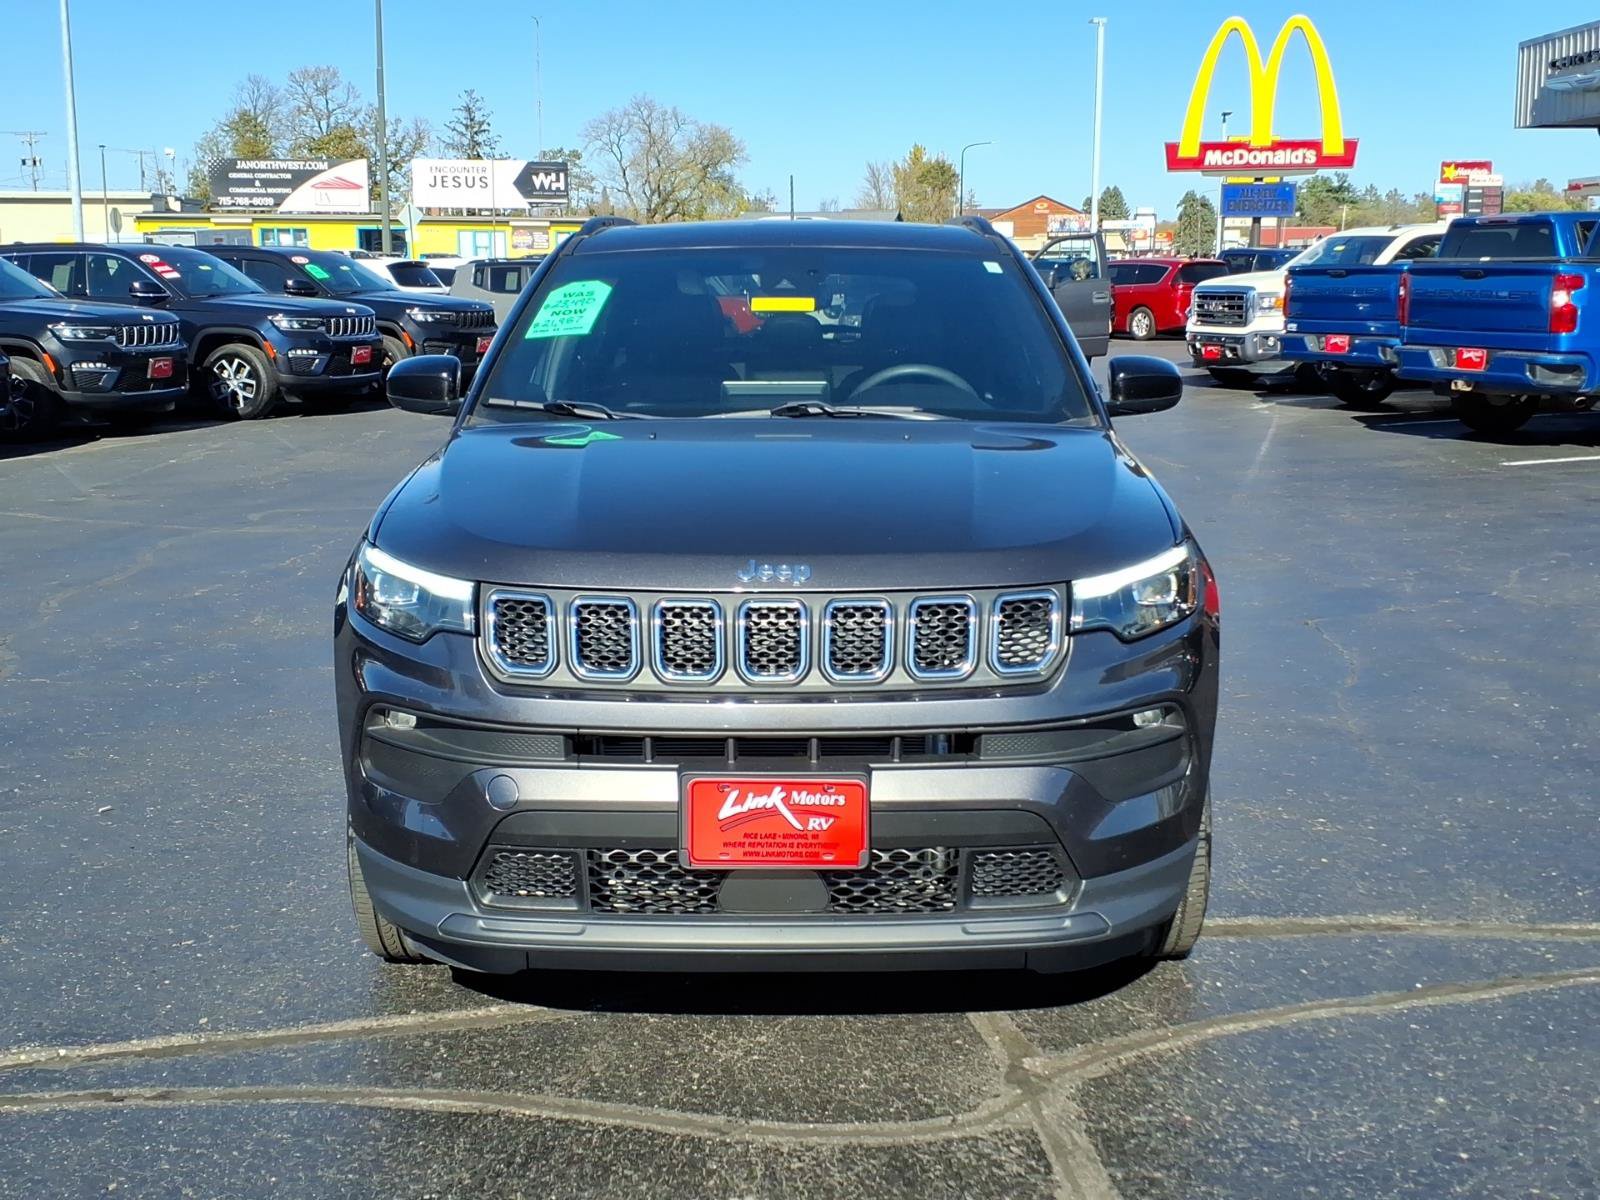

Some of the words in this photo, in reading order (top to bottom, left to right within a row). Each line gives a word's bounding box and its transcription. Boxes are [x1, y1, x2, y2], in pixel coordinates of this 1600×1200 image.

[1203, 149, 1317, 166] McDonald's
[235, 160, 329, 170] JANORTHWEST.COM
[429, 166, 488, 174] ENCOUNTER
[428, 175, 489, 189] JESUS
[550, 308, 587, 317] NOW
[736, 559, 812, 586] Jeep
[717, 786, 805, 831] Link
[789, 790, 846, 806] Motors
[806, 817, 835, 831] RV
[743, 832, 758, 840] RICE
[760, 832, 777, 840] LAKE
